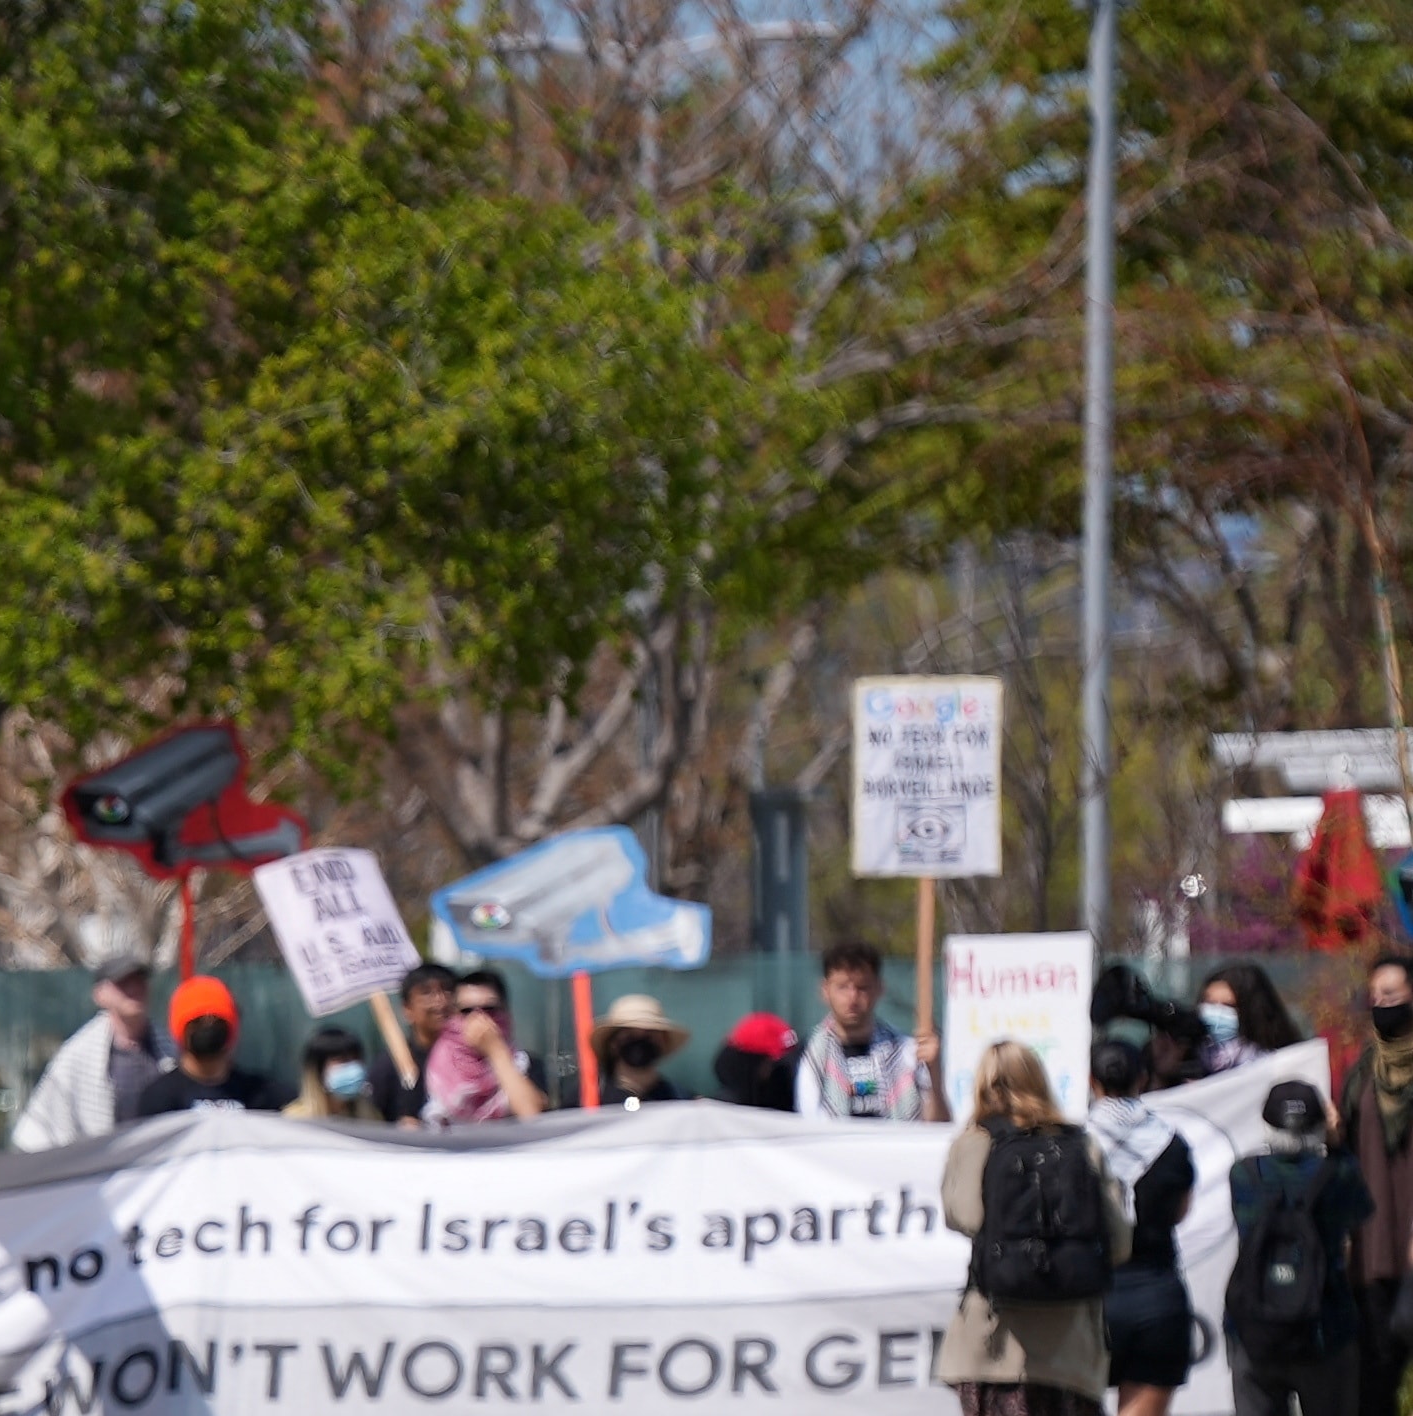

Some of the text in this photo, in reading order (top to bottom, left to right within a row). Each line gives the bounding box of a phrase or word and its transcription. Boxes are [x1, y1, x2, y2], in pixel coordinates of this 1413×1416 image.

[950, 951, 1078, 997] Human
[24, 1247, 104, 1293] no
[126, 1204, 272, 1264] tech
[294, 1204, 392, 1252] for
[420, 1199, 677, 1253] Israel's
[320, 1341, 577, 1400] WORK
[607, 1337, 778, 1399] FOR
